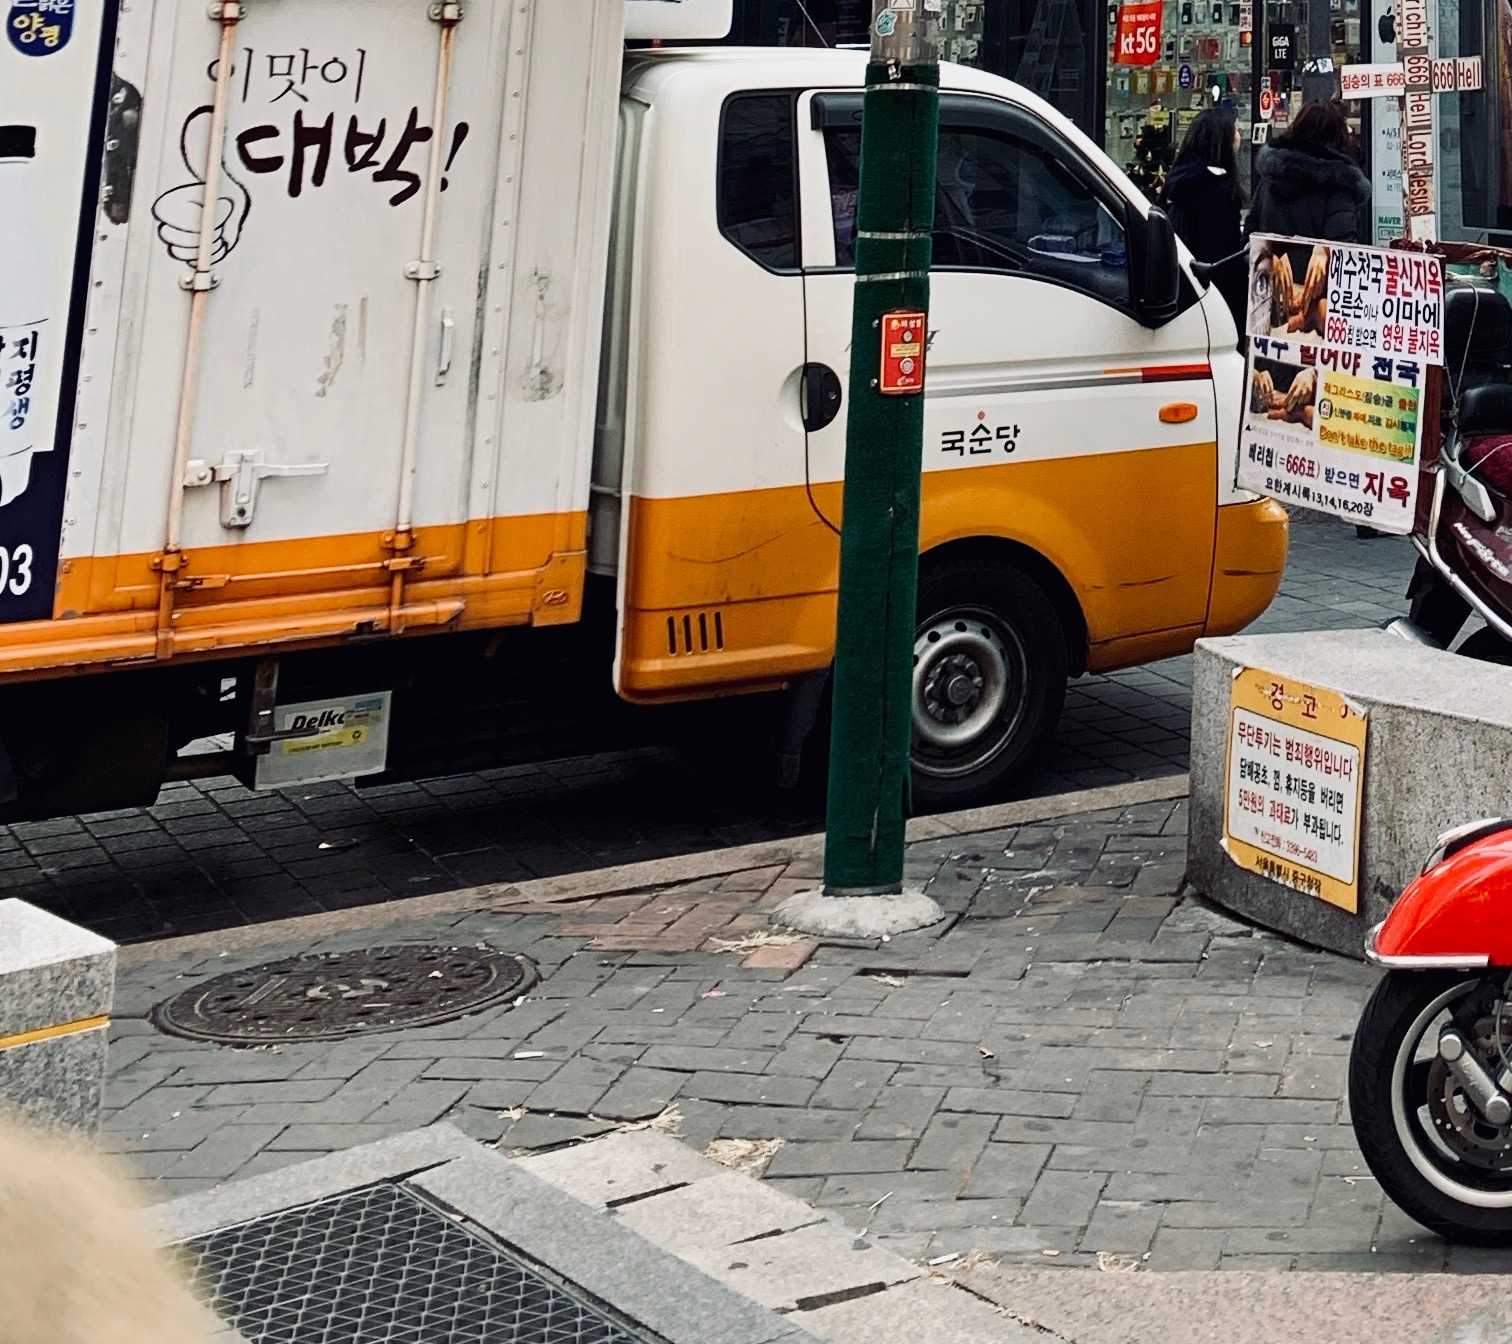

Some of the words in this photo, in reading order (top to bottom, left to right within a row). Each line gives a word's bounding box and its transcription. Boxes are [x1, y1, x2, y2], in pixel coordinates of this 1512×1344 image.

[12, 13, 61, 49] 양평
[1120, 32, 1136, 55] kt
[1136, 26, 1157, 54] 5G
[1272, 36, 1290, 48] GIGA
[1274, 48, 1288, 60] LTE
[1406, 55, 1430, 85] 666
[267, 46, 366, 103] 맛이
[1341, 73, 1371, 91] 짐승의
[1374, 73, 1384, 88] 표
[1386, 72, 1406, 87] 666
[1432, 61, 1455, 90] 666
[1457, 58, 1482, 90] Hell
[1409, 91, 1431, 124] Hell
[237, 107, 469, 207] 대박!
[1408, 130, 1431, 168] Lord
[1408, 170, 1430, 215] Jesus
[1378, 215, 1401, 226] NAVER
[1329, 248, 1384, 295] 예수천국
[1384, 254, 1442, 302] 불신지옥
[1329, 289, 1379, 322] 오른손이나
[1382, 297, 1442, 331] 이마에
[1381, 324, 1405, 355] 영원
[1407, 325, 1441, 359] 불지옥
[941, 423, 1021, 457] 국순당
[1368, 438, 1388, 453] the
[1325, 466, 1361, 490] 받으면
[1363, 471, 1412, 508] 지옥
[1237, 720, 1282, 758] 무단투기는
[1285, 737, 1353, 781] 범죄행위입니다
[1285, 773, 1316, 805] 휴지등을
[1320, 786, 1345, 815] 버리면
[1238, 788, 1266, 814] 5만원의
[1269, 801, 1299, 830] 과태료가
[1303, 813, 1344, 846] 부과됩니다.
